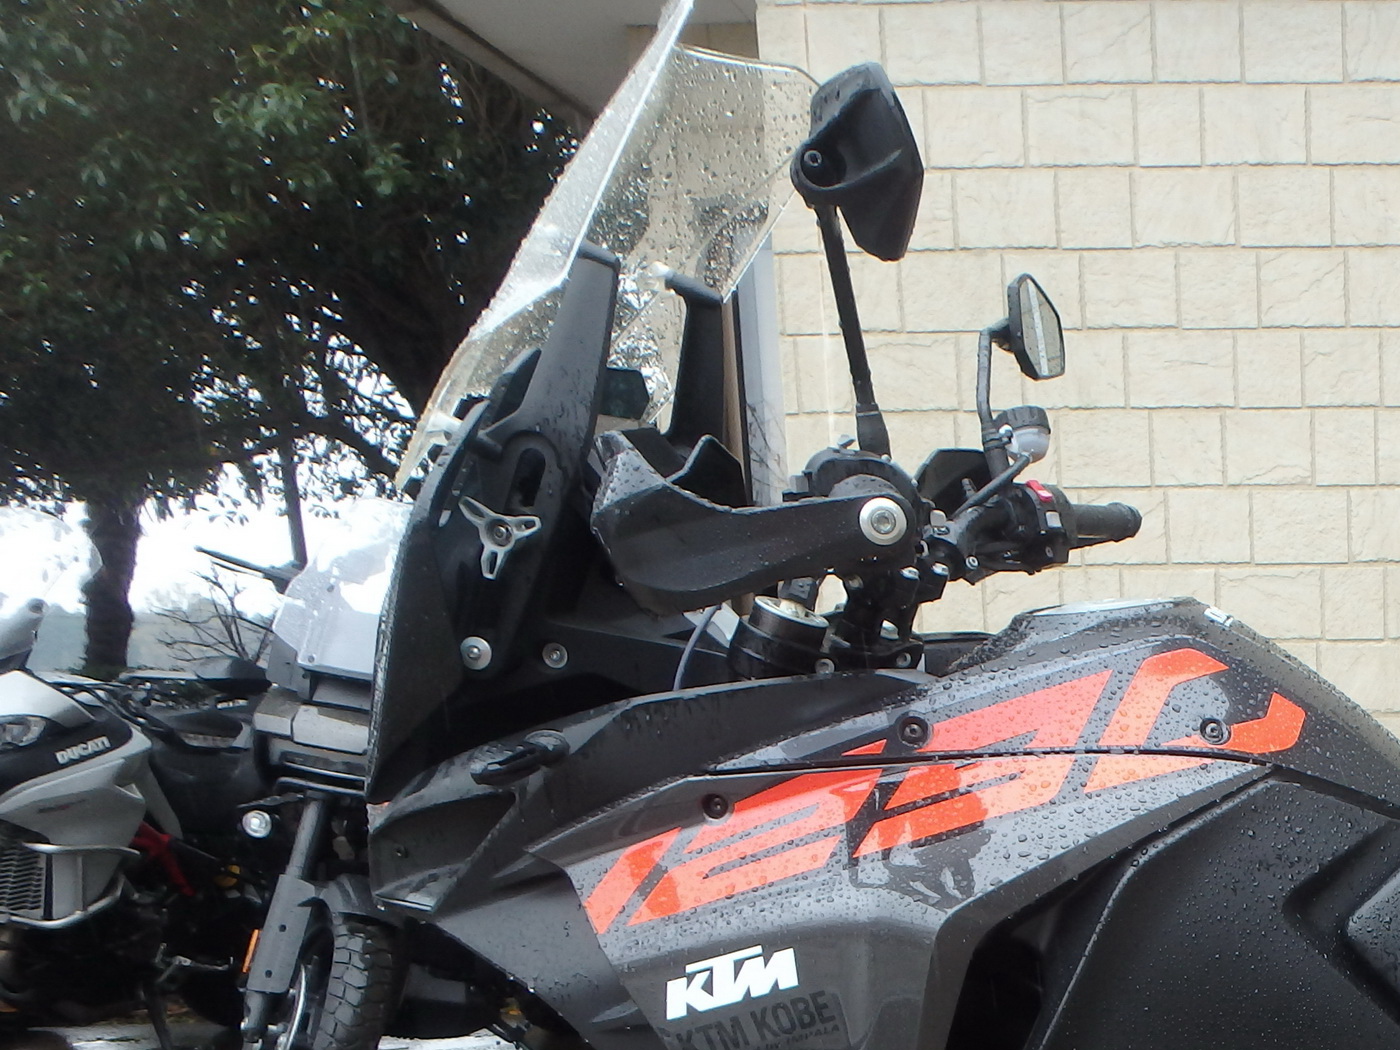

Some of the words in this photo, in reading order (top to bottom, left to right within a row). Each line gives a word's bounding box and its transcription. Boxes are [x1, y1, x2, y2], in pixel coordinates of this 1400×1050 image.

[55, 735, 111, 765] DUCATI
[666, 944, 799, 1020] KTM
[750, 990, 837, 1042] KOBE
